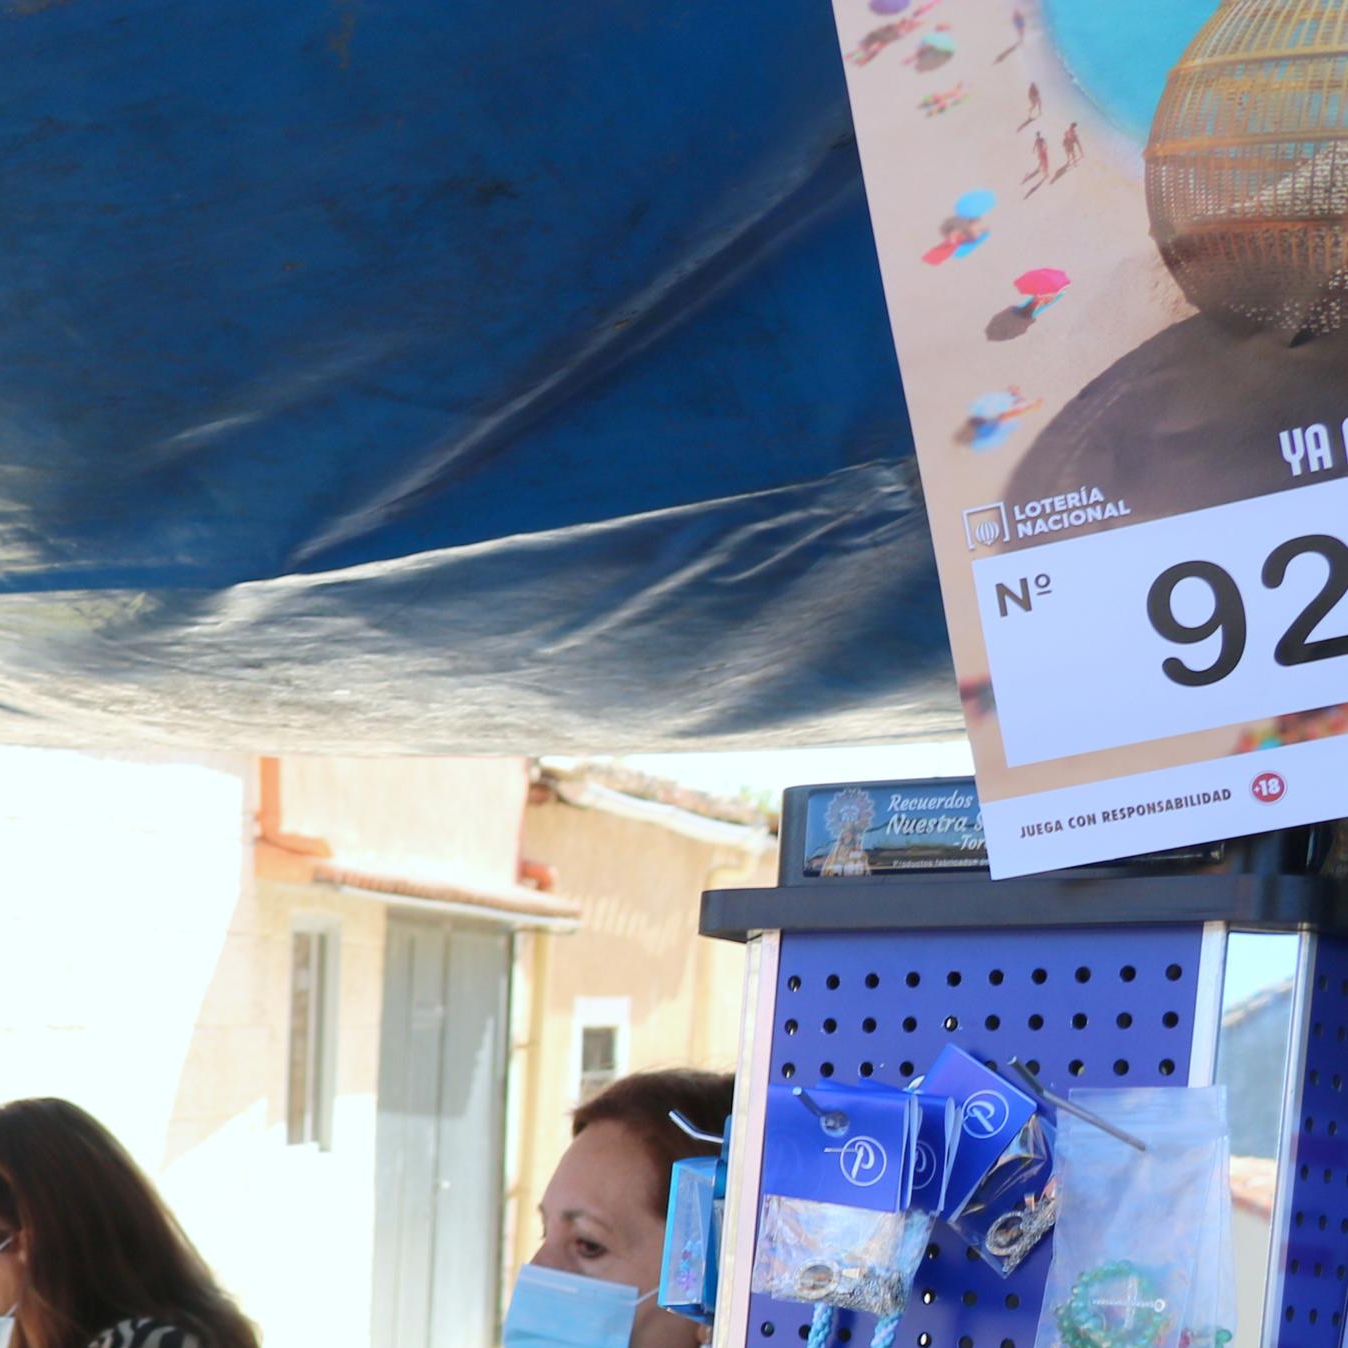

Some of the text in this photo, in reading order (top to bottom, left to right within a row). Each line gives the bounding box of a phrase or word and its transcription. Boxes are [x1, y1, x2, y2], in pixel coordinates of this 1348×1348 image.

[1279, 423, 1333, 476] YA
[1013, 486, 1104, 521] LOTERÍA
[1017, 500, 1131, 538] NACIONAL
[1146, 534, 1348, 688] 92
[887, 789, 974, 812] Recuerdos
[1020, 819, 1063, 839] JUEGA
[1068, 813, 1097, 830] CON
[1102, 788, 1231, 823] RESPONSABILIDAD
[885, 812, 968, 836] Nuestra
